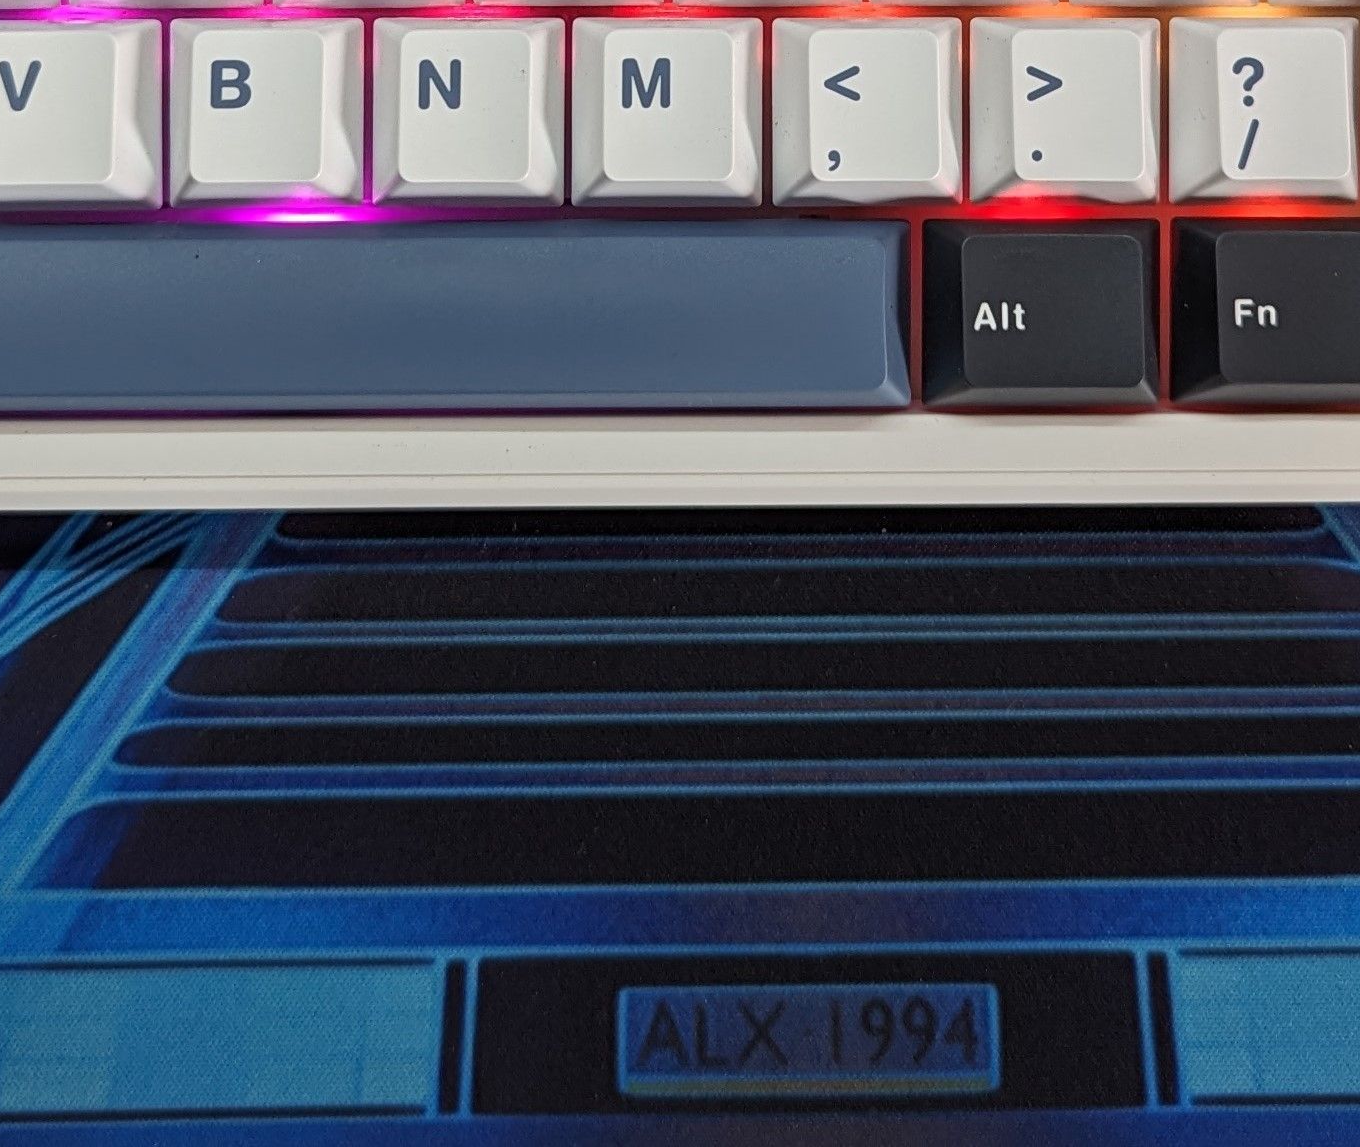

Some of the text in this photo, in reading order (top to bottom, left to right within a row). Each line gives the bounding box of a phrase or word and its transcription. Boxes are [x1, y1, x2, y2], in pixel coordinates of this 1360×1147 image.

[211, 60, 251, 108] B
[419, 59, 461, 109] N
[622, 58, 670, 108] M
[824, 66, 860, 101] <
[1027, 66, 1062, 101] >
[1233, 57, 1264, 106] ?
[1238, 119, 1259, 170] /
[974, 302, 1025, 330] Alt
[1235, 299, 1276, 326] Fn
[639, 995, 978, 1068] ALX 1994
